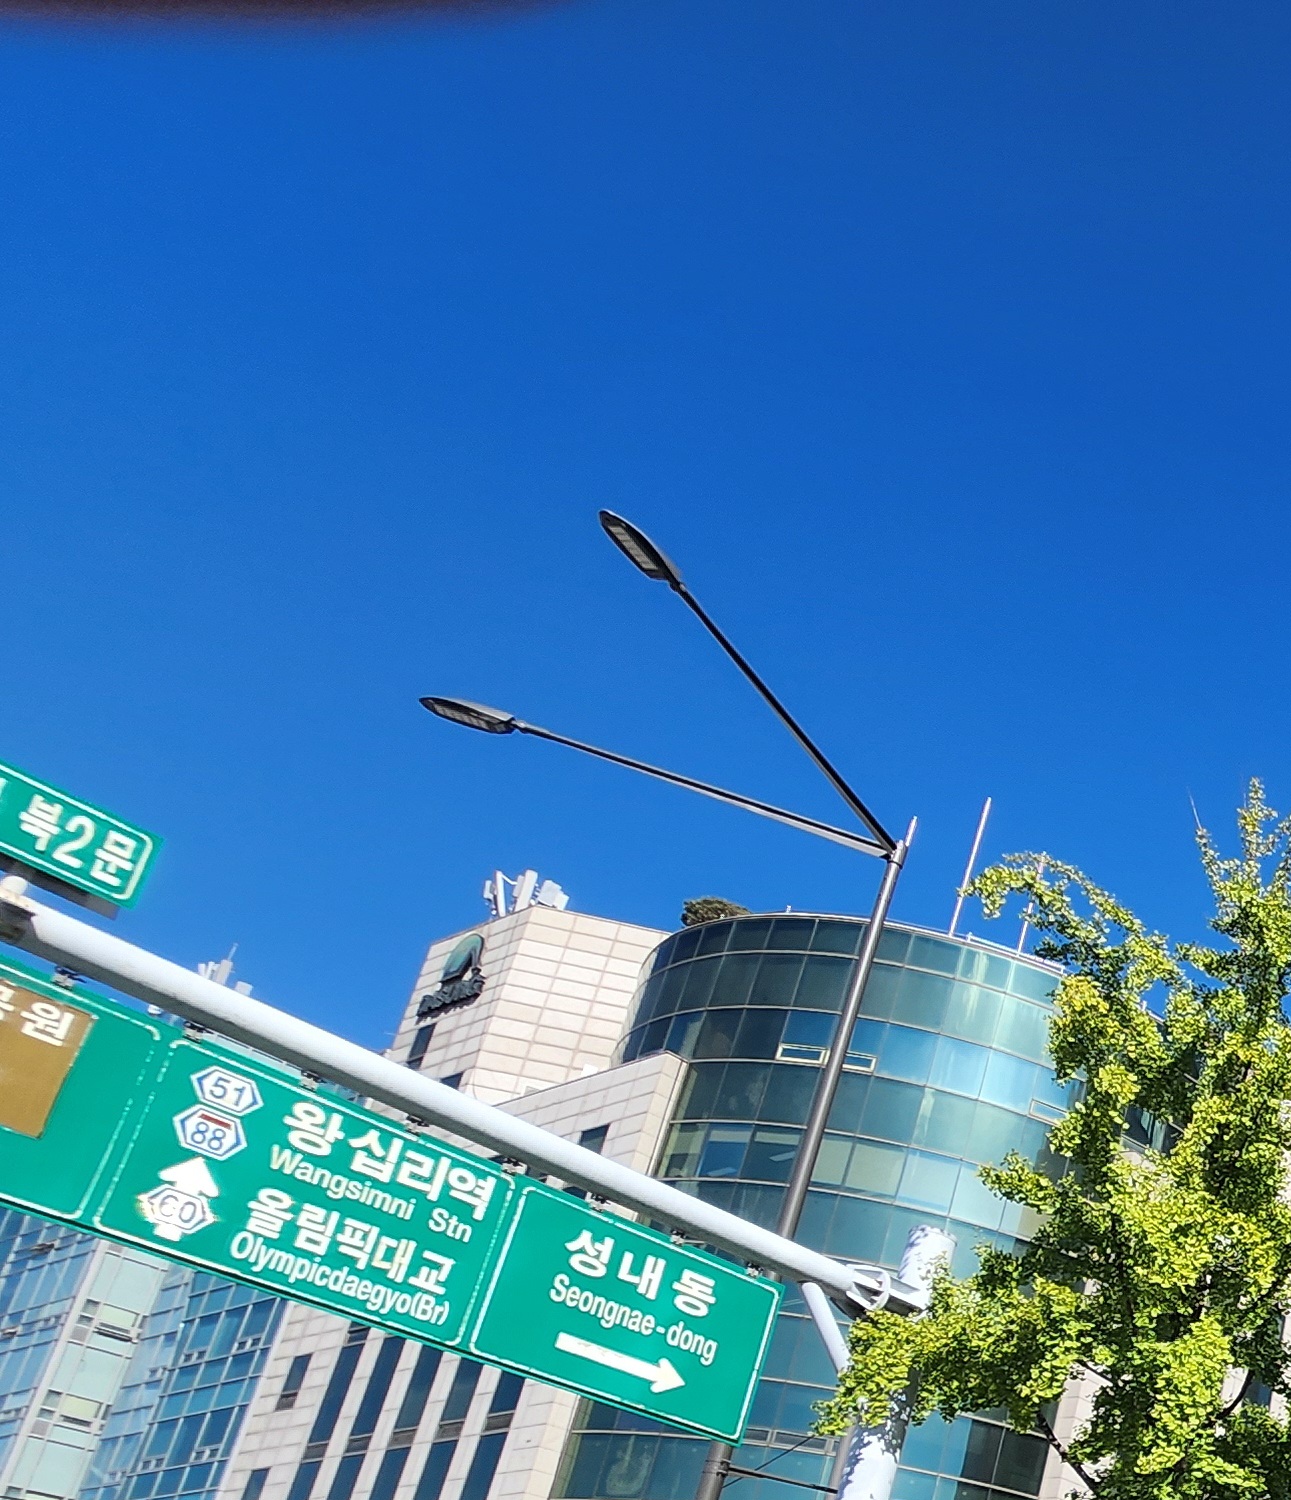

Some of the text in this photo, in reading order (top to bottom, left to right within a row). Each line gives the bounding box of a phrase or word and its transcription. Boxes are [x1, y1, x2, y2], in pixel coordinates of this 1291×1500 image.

[18, 793, 137, 887] 북2문
[191, 1121, 227, 1152] 88
[209, 1076, 247, 1108] 51
[269, 1144, 474, 1244] Wangsimni Stn
[283, 1101, 498, 1222] 왕십리역
[230, 1231, 451, 1327] Olympicdaegyo(Br)
[245, 1187, 457, 1296] 올림픽대교
[564, 1229, 717, 1318] 성내동
[549, 1273, 719, 1367] Seongnae-dong
